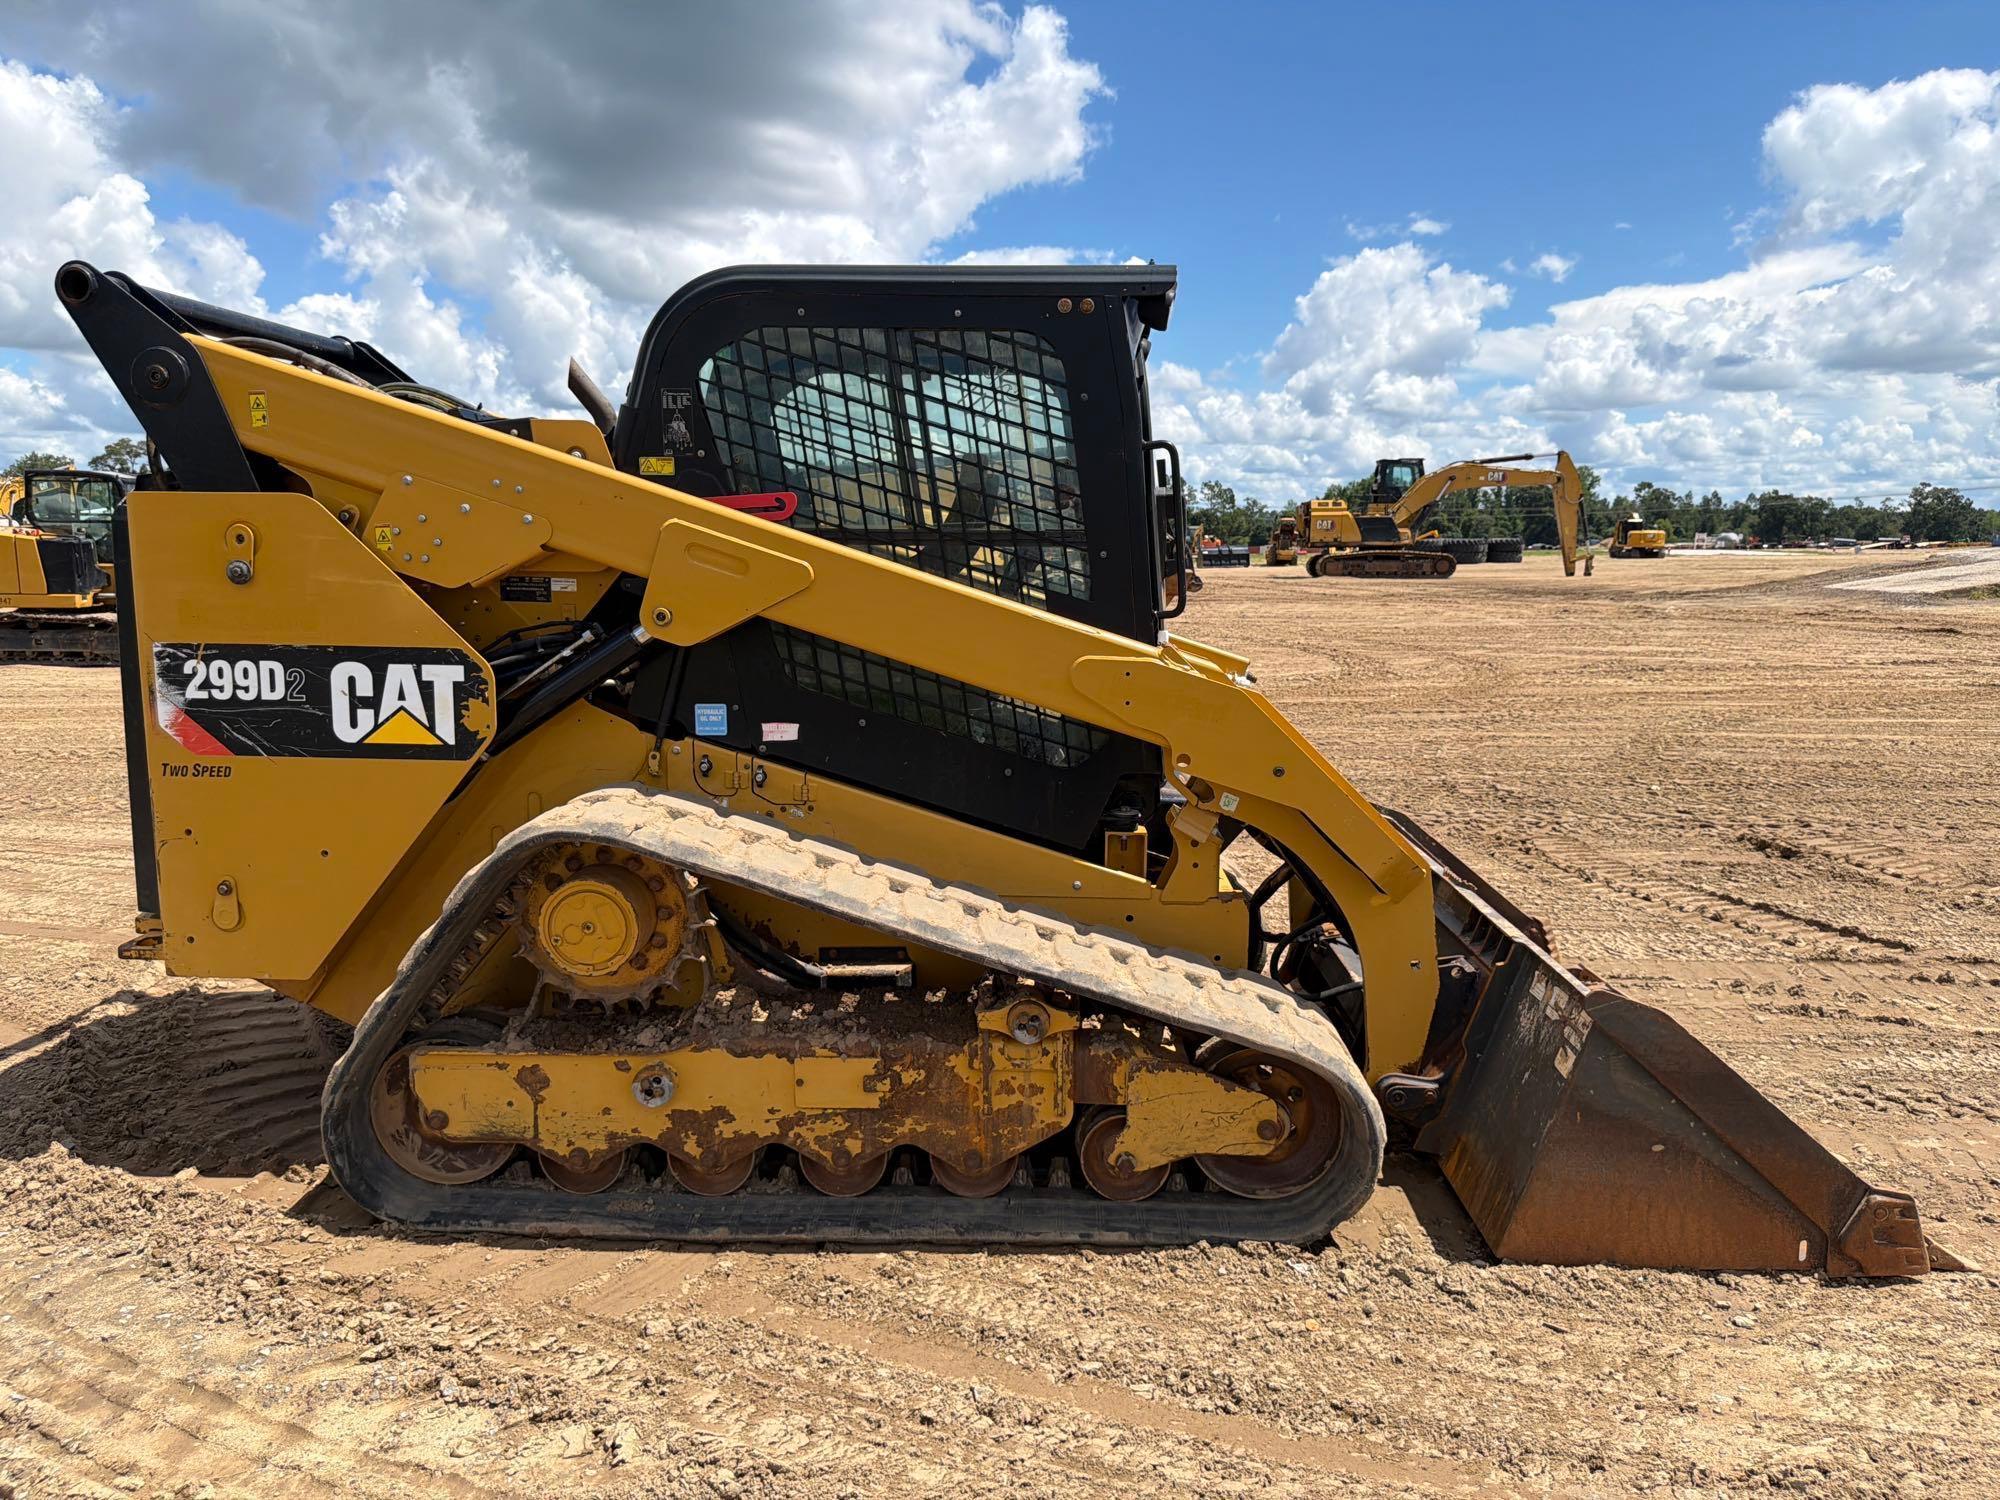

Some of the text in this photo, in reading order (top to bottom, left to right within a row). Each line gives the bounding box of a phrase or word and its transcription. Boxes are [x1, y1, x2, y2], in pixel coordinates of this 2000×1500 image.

[1488, 471, 1504, 481] CAT
[1316, 519, 1332, 530] CAT
[330, 661, 465, 745] CAT
